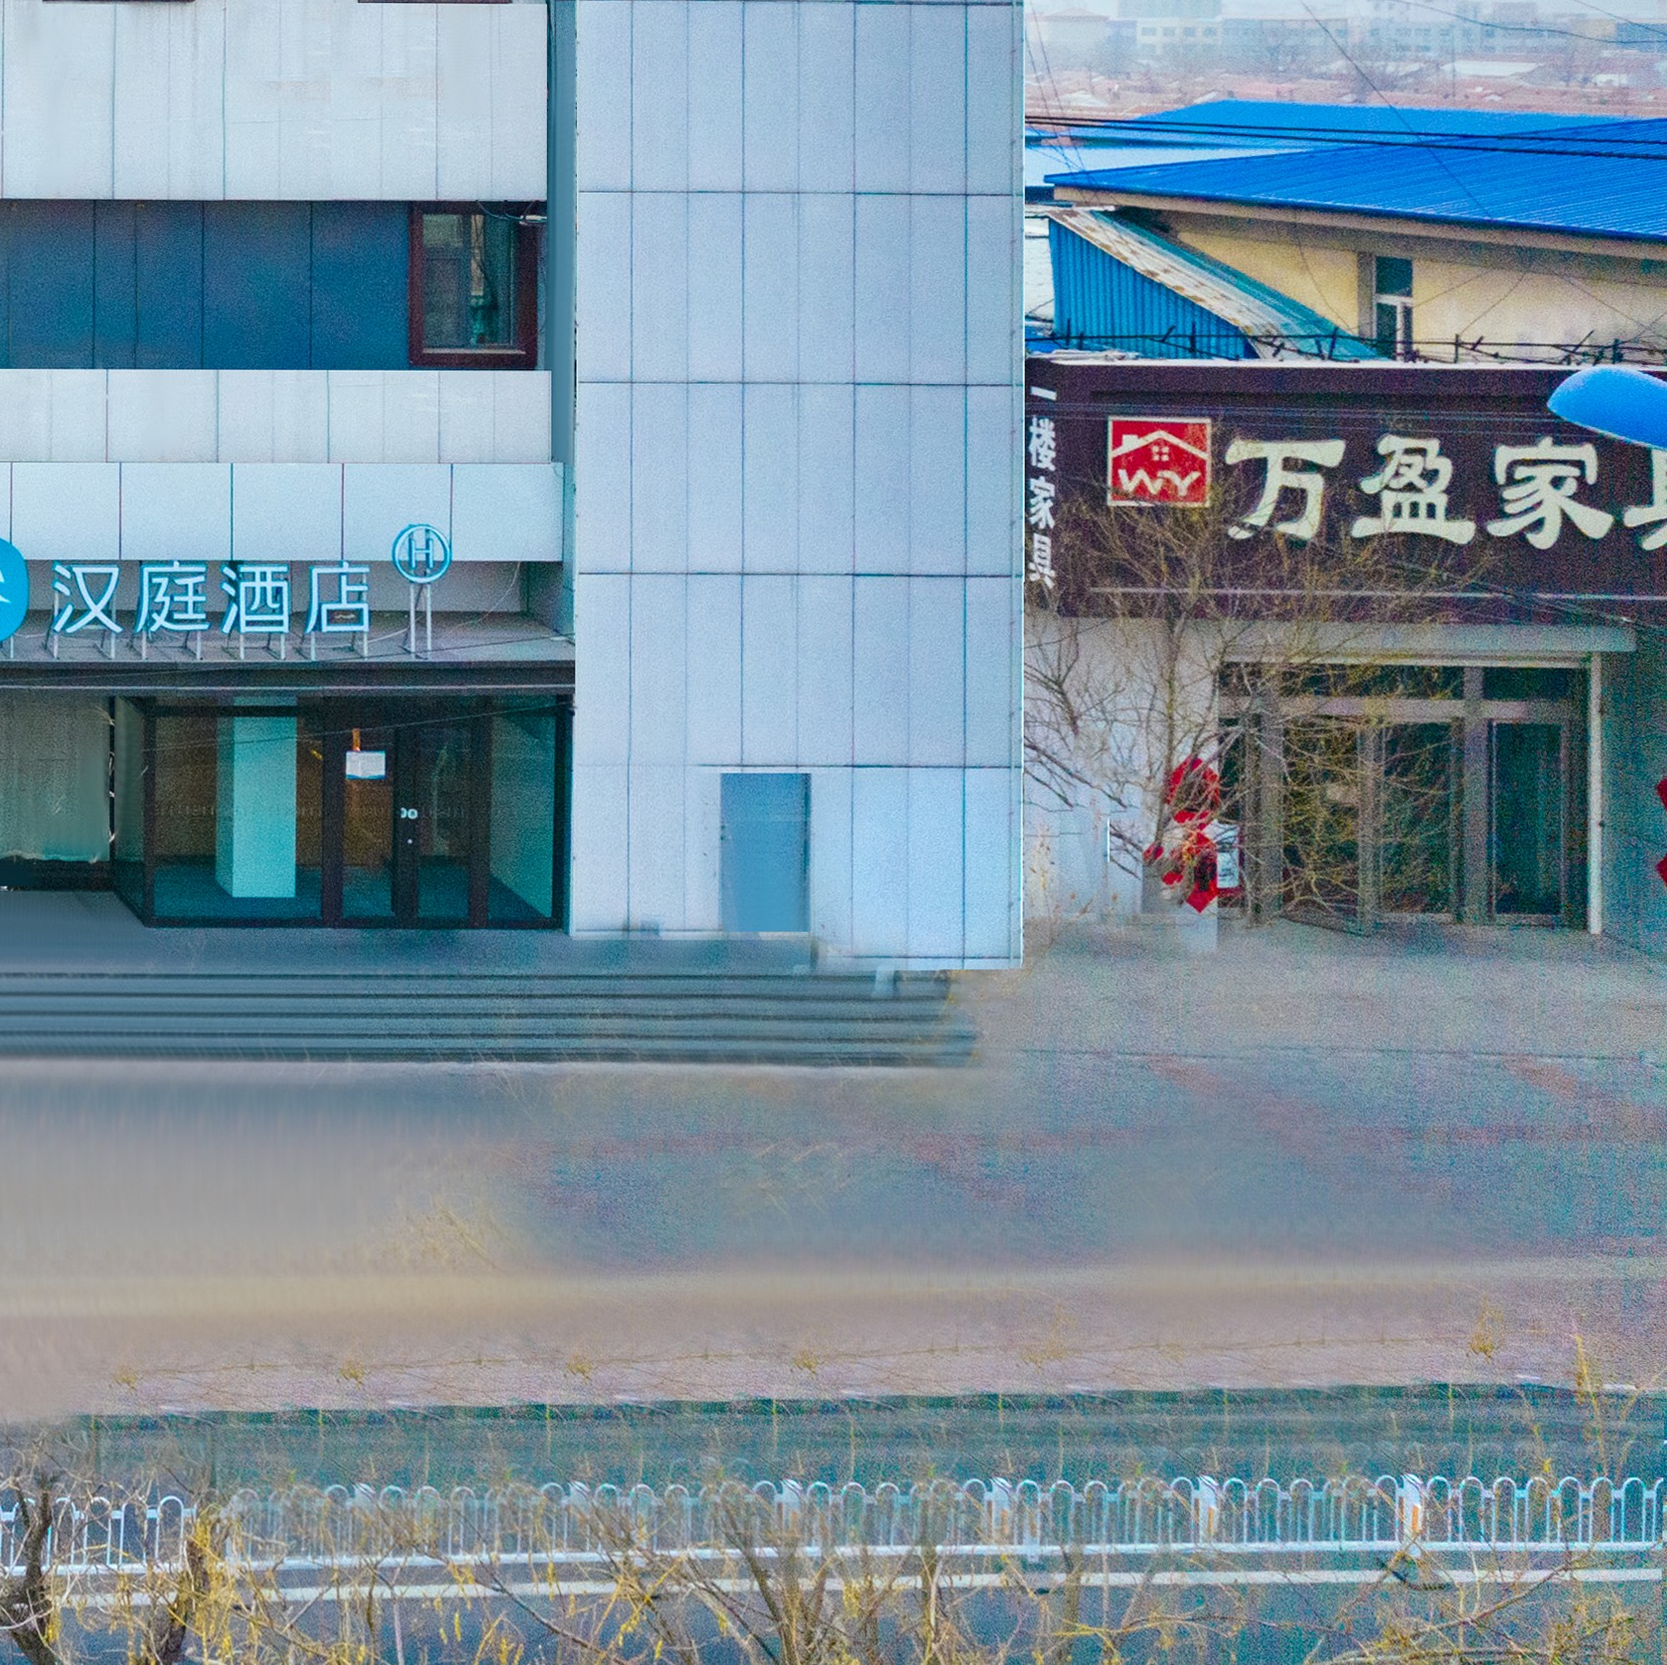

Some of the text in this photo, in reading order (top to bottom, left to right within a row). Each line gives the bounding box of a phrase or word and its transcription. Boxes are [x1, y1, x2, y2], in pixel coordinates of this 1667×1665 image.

[1028, 386, 1058, 590] 一楼家具
[1117, 468, 1202, 497] WY
[51, 561, 370, 634] 汉庭酒店
